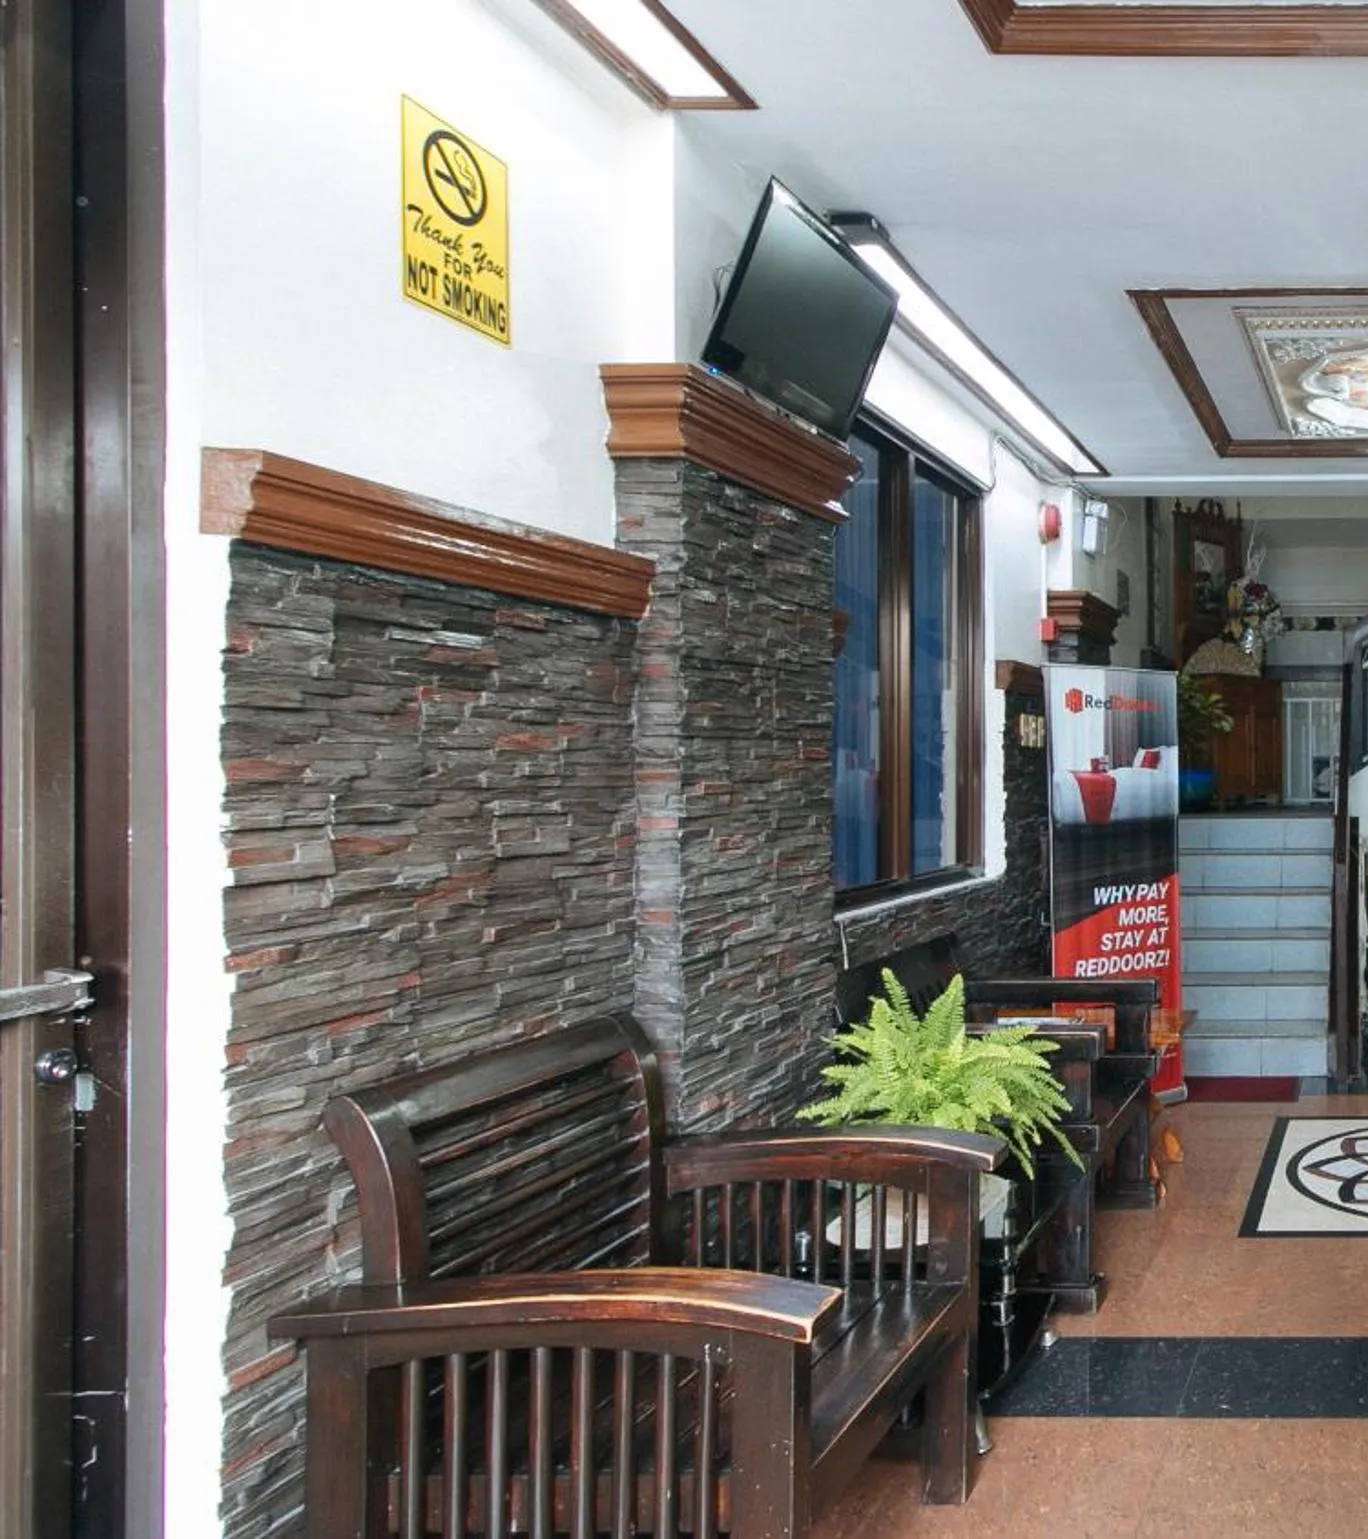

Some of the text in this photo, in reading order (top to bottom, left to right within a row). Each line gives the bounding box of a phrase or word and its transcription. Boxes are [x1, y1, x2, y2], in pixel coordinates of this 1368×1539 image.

[406, 203, 505, 279] Thank You
[443, 252, 472, 279] FOR
[407, 254, 507, 334] NOT SMOKING
[1093, 881, 1169, 906] WHY PAY
[1118, 905, 1170, 928] MORE,
[1100, 926, 1169, 951] STAY AT
[1075, 949, 1171, 977] REDDOORZ!
